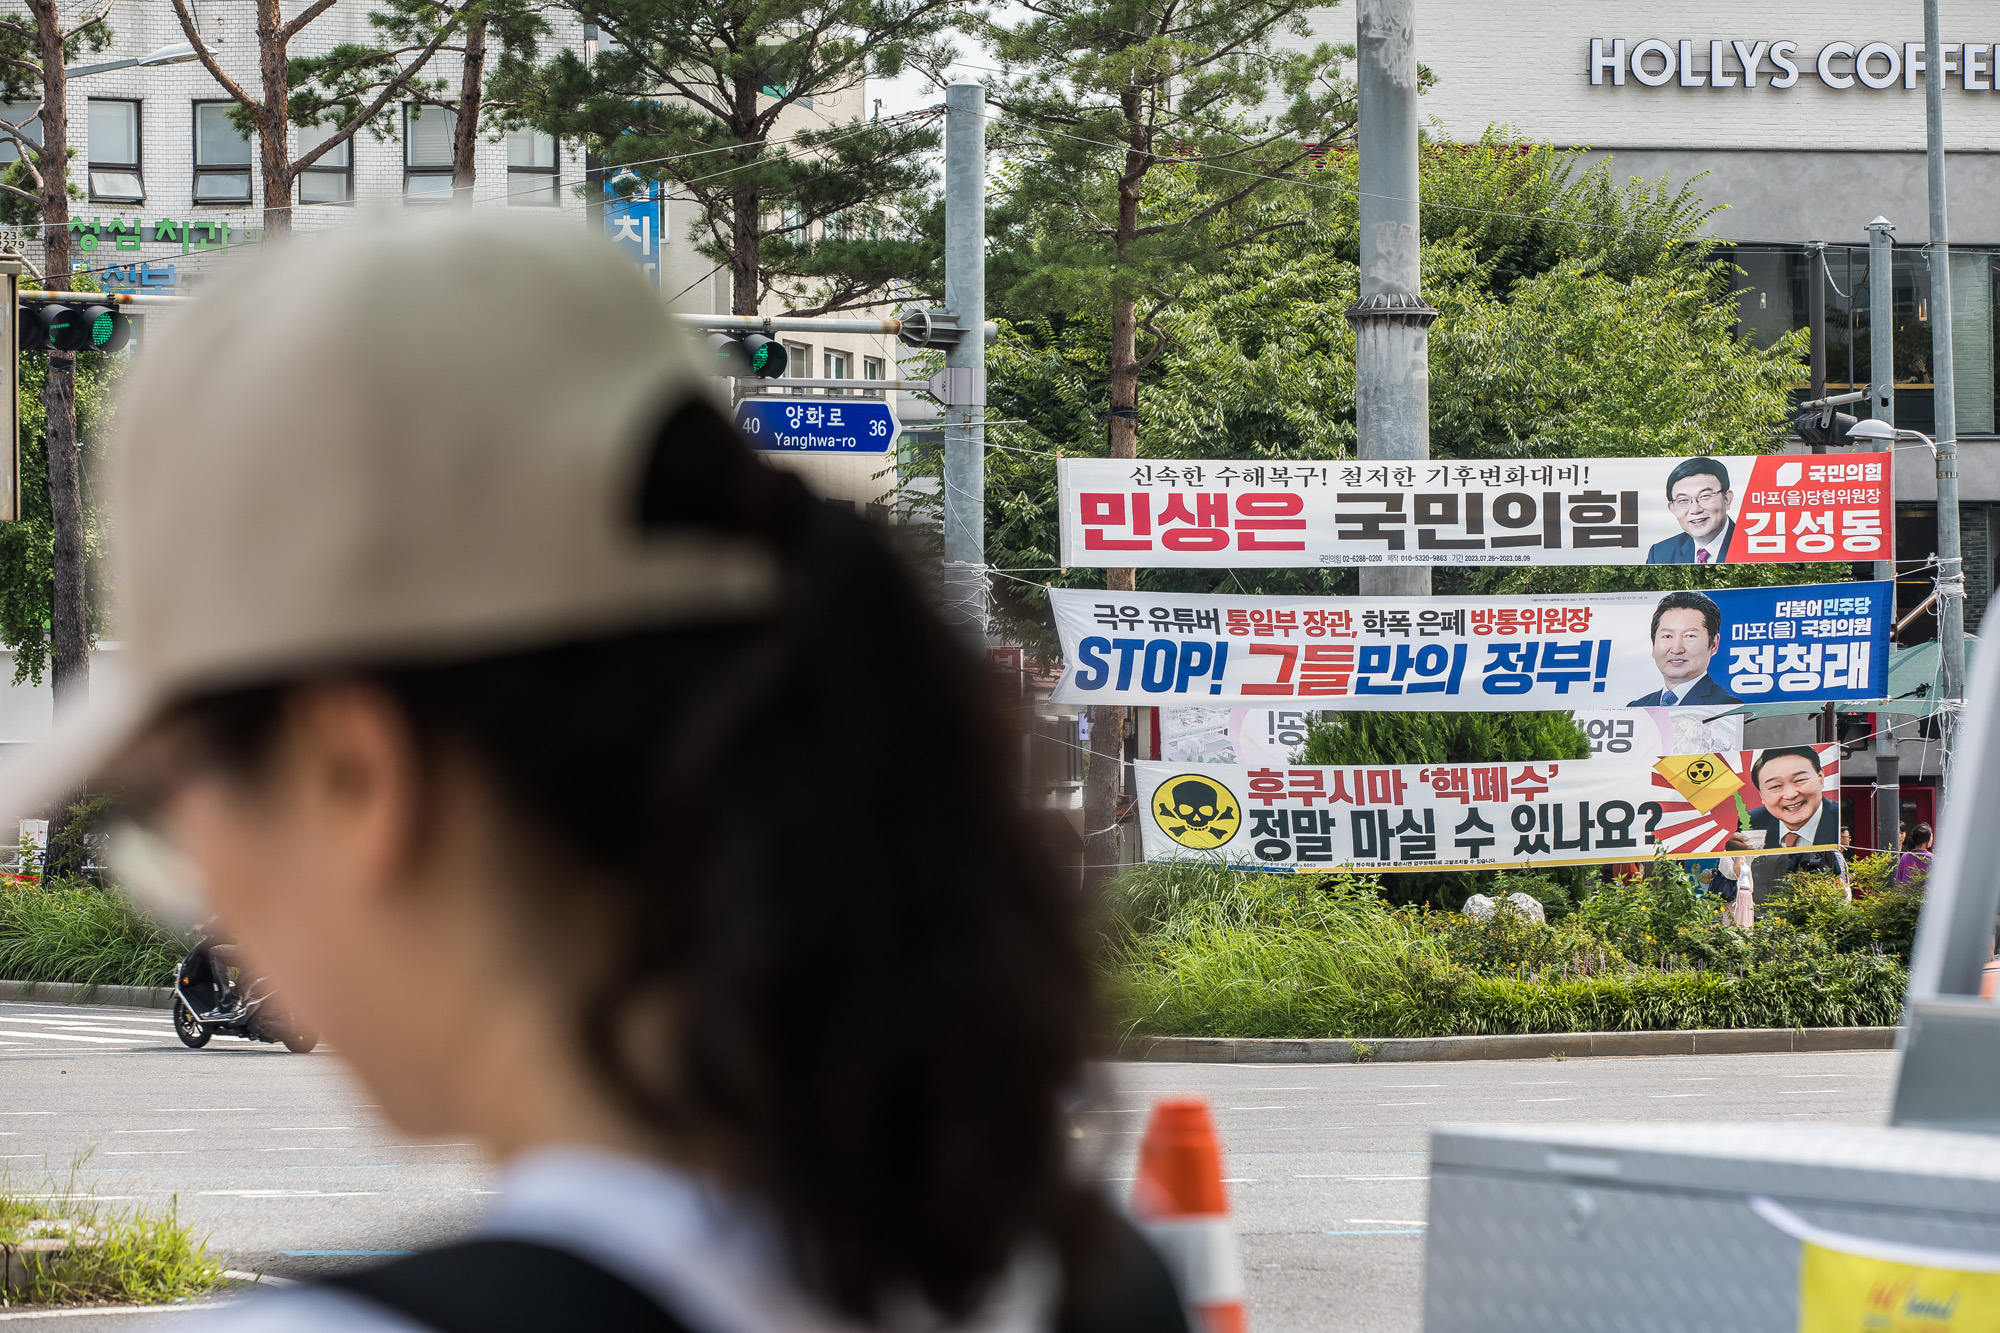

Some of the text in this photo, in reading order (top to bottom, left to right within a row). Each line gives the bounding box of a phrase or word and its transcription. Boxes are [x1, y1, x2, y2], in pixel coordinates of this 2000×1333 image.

[1590, 38, 2000, 91] HOLLYS COFFE
[0, 231, 17, 239] 23
[69, 217, 141, 251] 성심
[155, 218, 231, 254] 치과
[742, 417, 761, 434] 40
[785, 405, 845, 429] 양화로
[868, 420, 887, 436] 36
[774, 432, 856, 449] Yanghwa-ro
[1129, 465, 1589, 488] 신속한 수해복구! 철저한 기후변화대비!
[1808, 463, 1882, 483] 국민의힘
[1751, 488, 1881, 506] 마포(을)당협위원장
[1080, 490, 1639, 551] 민생은 국민의힘
[1744, 509, 1883, 554] 김성동
[1775, 597, 1872, 618] 더불어민주당
[1094, 604, 1593, 638] 극우 유튜버 통일부 장관, 학폭 은폐 방통위원장
[1731, 617, 1872, 641] 마포(을) 국회의원
[1075, 636, 1612, 696] STOP! 그들만의 정부!
[1728, 641, 1871, 694] 정청래
[1247, 768, 1407, 806] 후쿠시마
[1249, 800, 1663, 862] 정말 마실 수 있나요?
